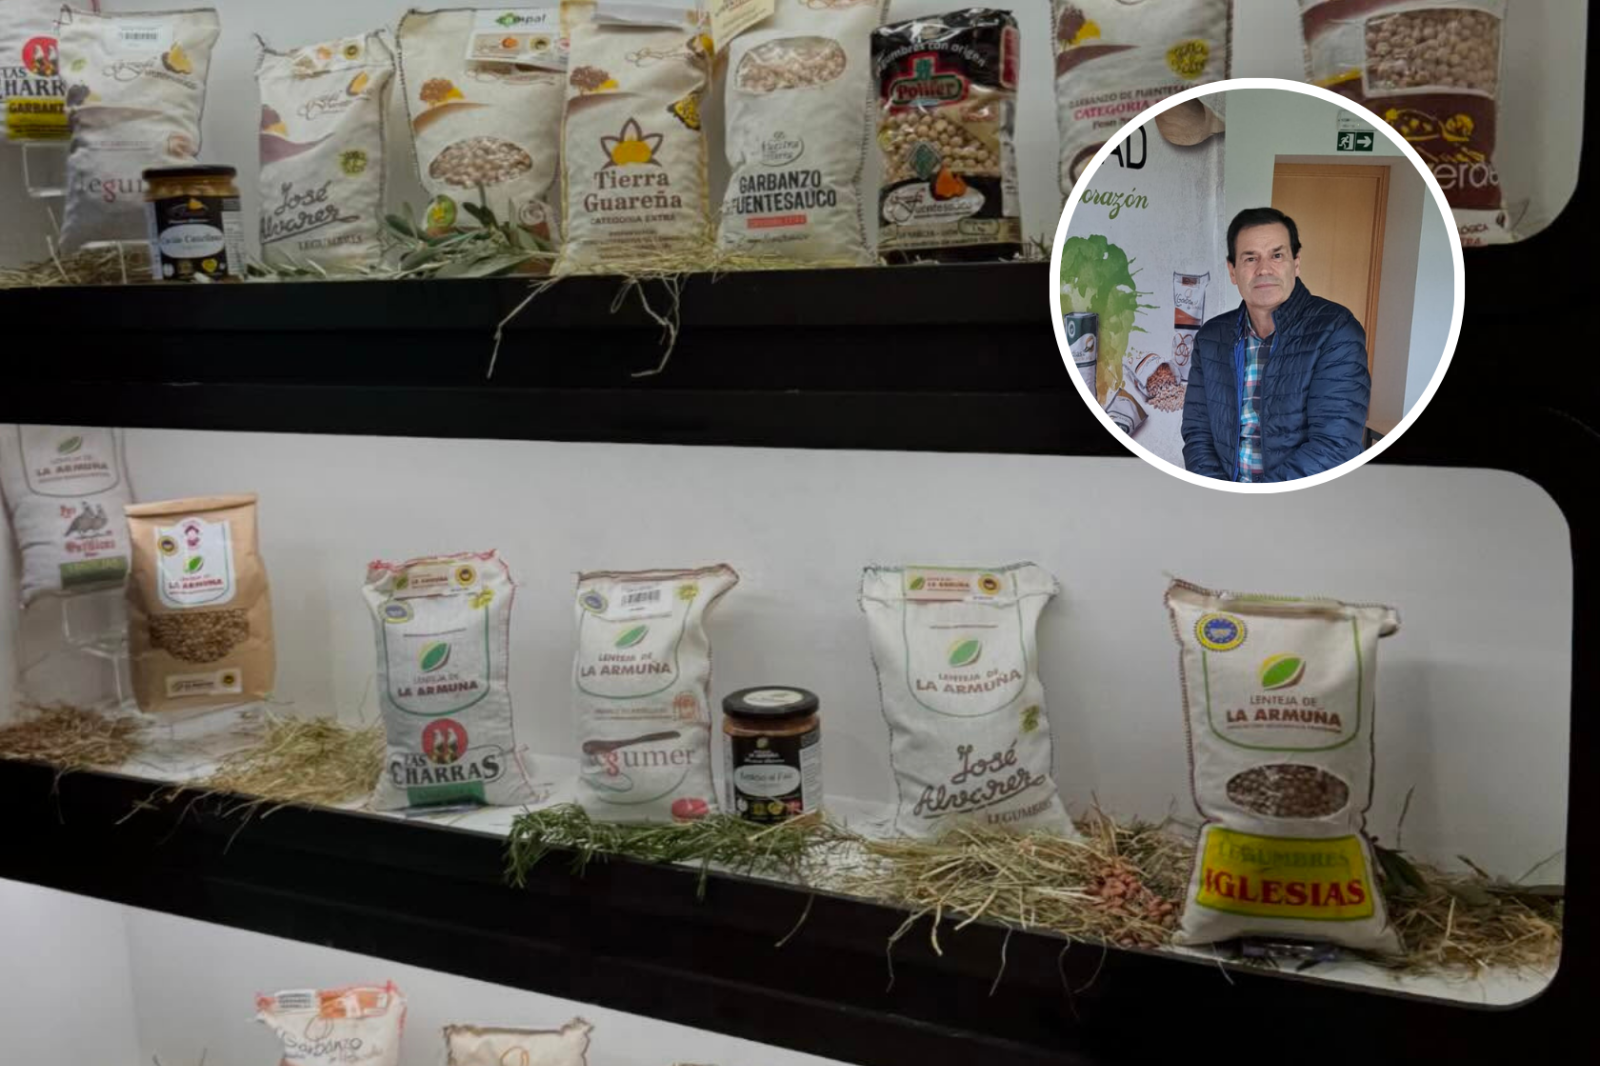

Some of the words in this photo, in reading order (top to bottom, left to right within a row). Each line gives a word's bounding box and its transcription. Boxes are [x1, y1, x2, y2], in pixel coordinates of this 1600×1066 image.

[928, 42, 948, 50] con
[951, 44, 986, 67] origen
[594, 171, 670, 190] Tierra
[739, 169, 822, 194] GARBANZO
[274, 180, 333, 217] José
[583, 191, 683, 213] Guareña
[581, 666, 597, 677] LA
[398, 687, 413, 698] LA
[916, 679, 937, 692] LA
[1250, 695, 1298, 706] LENTEJA
[1302, 697, 1318, 707] DE
[1226, 709, 1248, 723] LA
[390, 754, 500, 786] CHARRAS
[404, 754, 427, 768] LAS
[951, 738, 1019, 785] José
[1205, 868, 1366, 907] IGLESIAS
